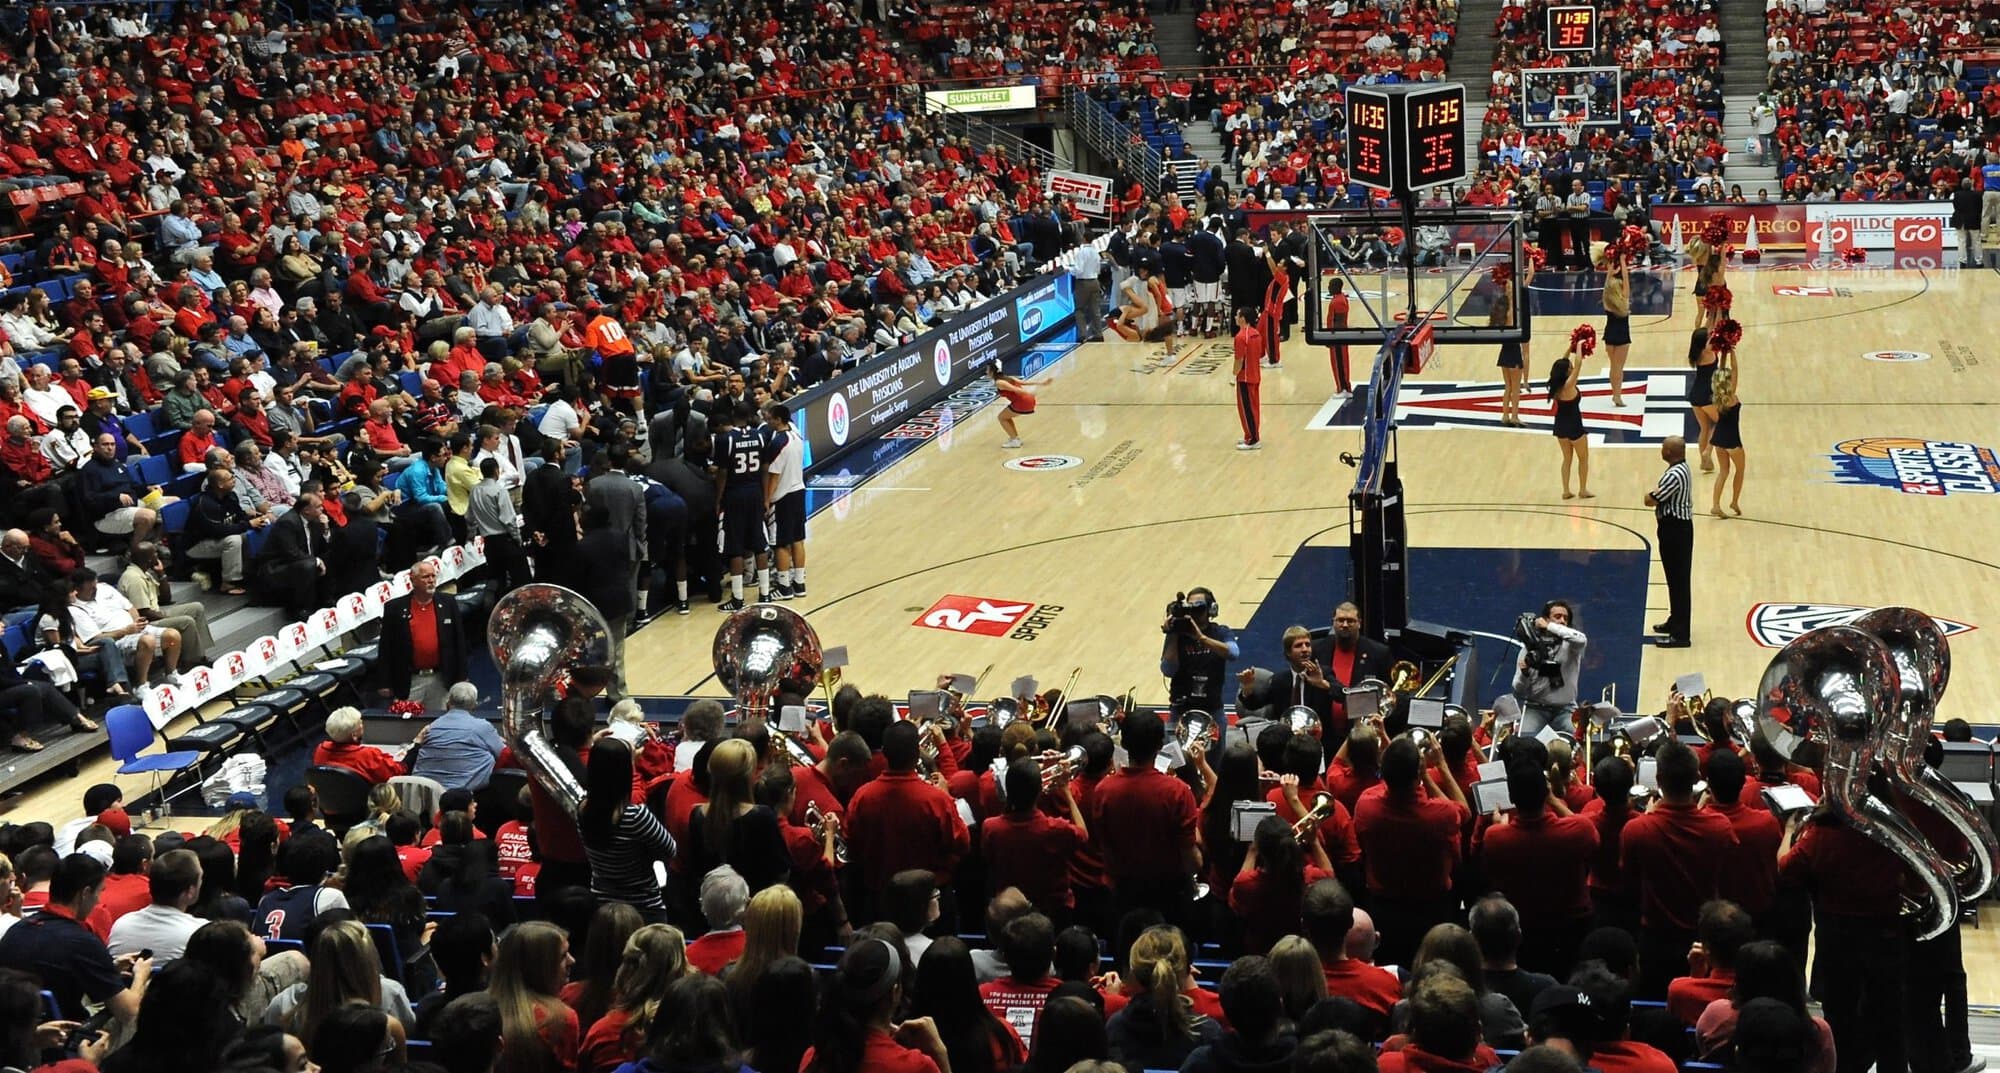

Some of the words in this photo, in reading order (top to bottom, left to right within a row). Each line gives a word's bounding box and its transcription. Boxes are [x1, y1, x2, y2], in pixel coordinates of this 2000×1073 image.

[1556, 12, 1590, 25] 11:35
[1560, 27, 1584, 45] 35
[949, 91, 1008, 104] SUNSTREET
[1354, 103, 1385, 129] 11:35
[1417, 98, 1459, 128] 11:35
[1357, 136, 1380, 174] 35
[1422, 133, 1453, 174] 35
[1051, 176, 1102, 199] ESPN
[1900, 224, 1937, 242] GO
[846, 383, 860, 400] THE
[859, 369, 889, 393] UNIVERSITY
[889, 361, 899, 378] OF
[897, 352, 922, 373] ARIZONA
[872, 377, 904, 405] PHYSICIANS
[734, 451, 760, 474] 35
[1888, 447, 1940, 484] SPORTS
[1925, 441, 1996, 493] CLASSIC
[924, 600, 1030, 631] 2K
[1010, 604, 1065, 642] SPORTS
[262, 909, 286, 940] 3
